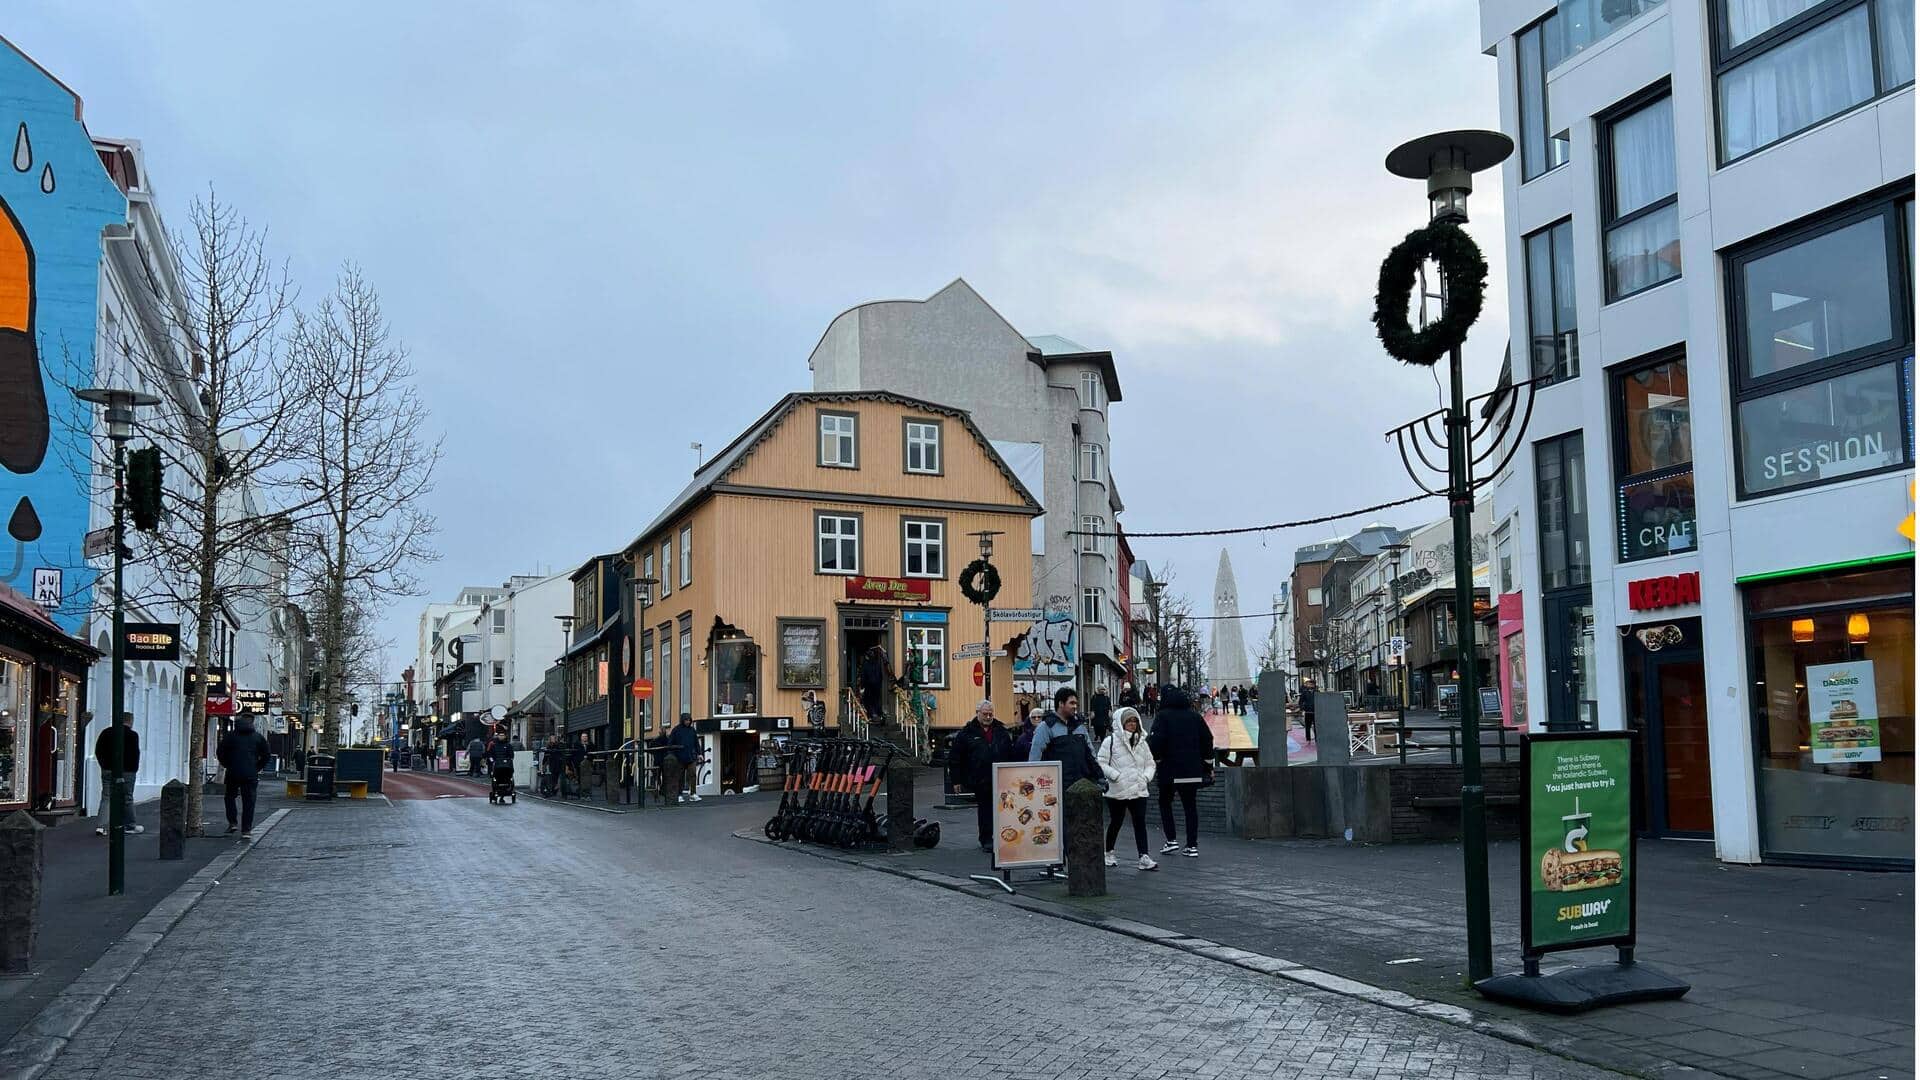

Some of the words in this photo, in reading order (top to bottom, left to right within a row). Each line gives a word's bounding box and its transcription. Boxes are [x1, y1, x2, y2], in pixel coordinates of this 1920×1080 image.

[1764, 431, 1884, 480] SESSION
[129, 633, 150, 644] Bao
[152, 633, 173, 644] Bite
[1579, 754, 1600, 762] Subway
[1563, 770, 1587, 778] Icelandic
[1545, 784, 1560, 792] You
[1561, 782, 1574, 792] just
[1575, 781, 1591, 790] have
[1592, 780, 1599, 788] to
[1600, 779, 1609, 788] try
[1609, 777, 1615, 786] it
[1556, 899, 1611, 922] SUBWAY
[1570, 924, 1584, 932] Fresh
